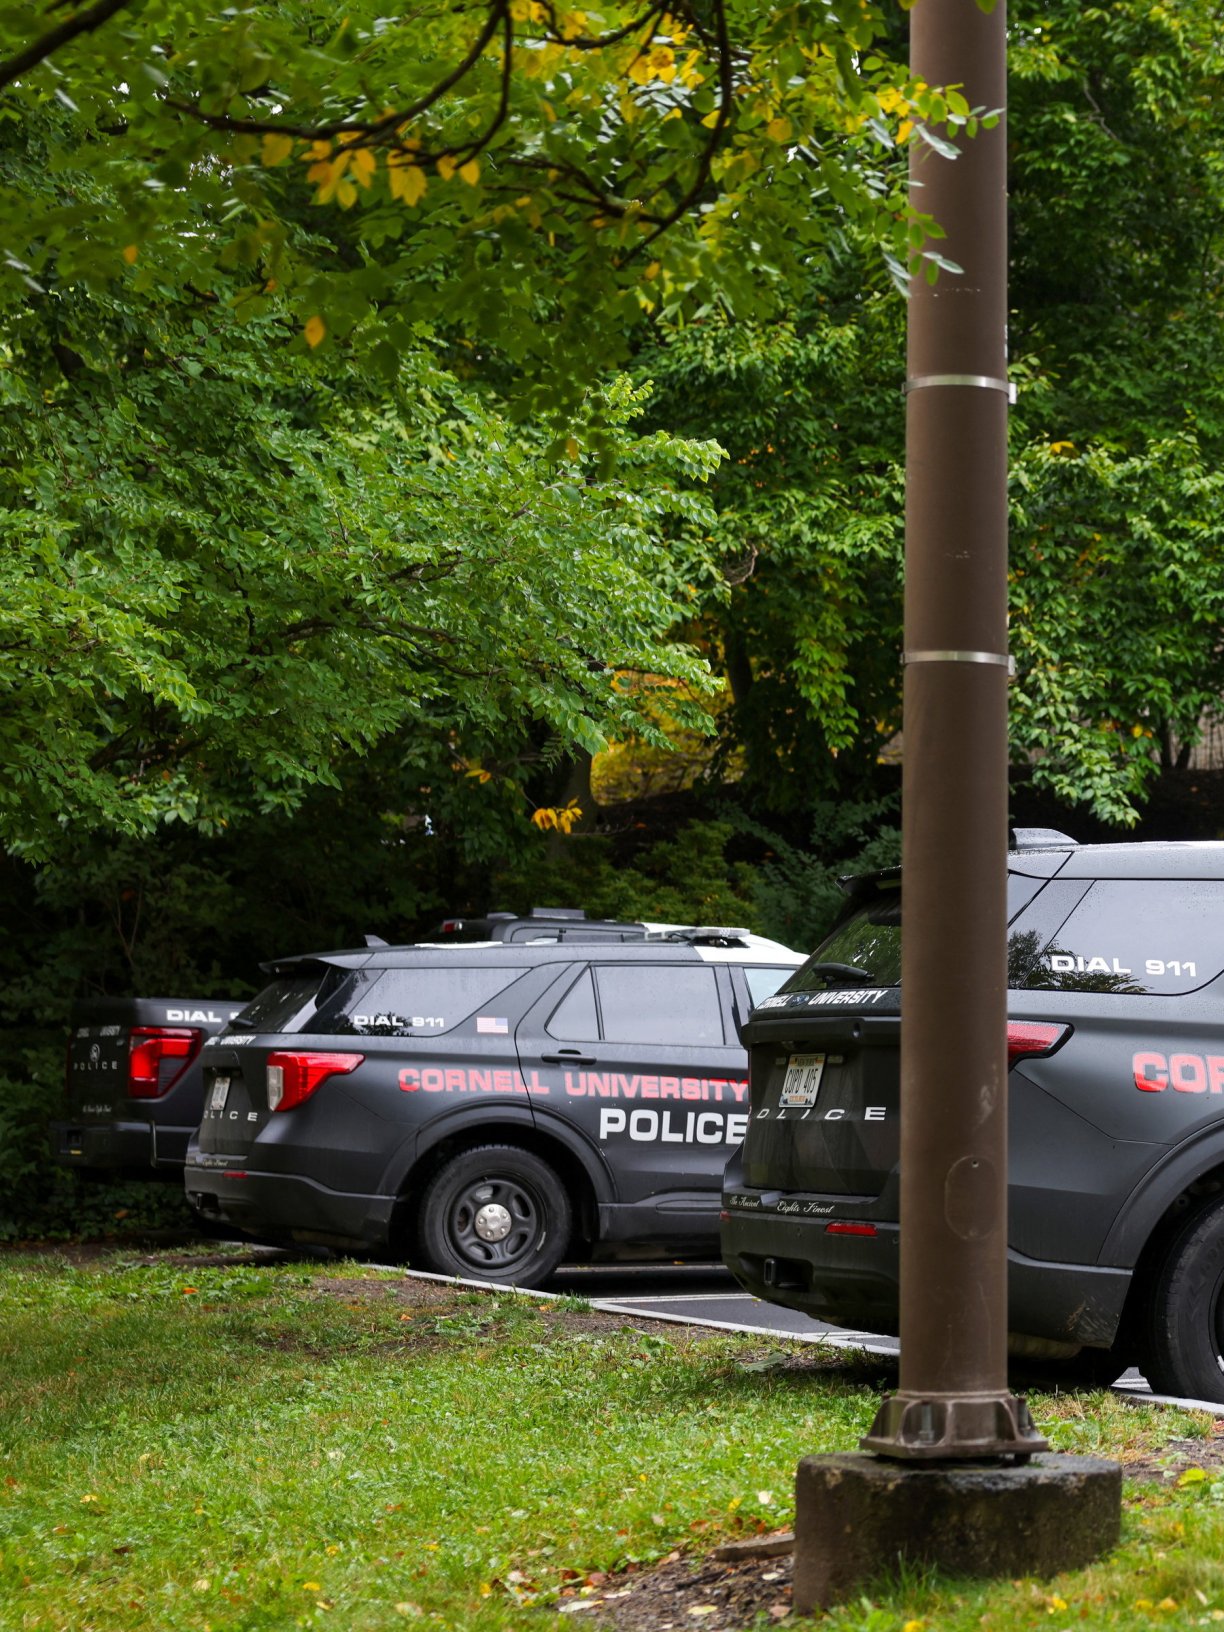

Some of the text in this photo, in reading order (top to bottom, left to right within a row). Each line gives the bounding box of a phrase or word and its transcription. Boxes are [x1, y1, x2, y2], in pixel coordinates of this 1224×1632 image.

[1051, 956, 1197, 977] DIAL 911
[807, 990, 889, 1006] UNIVERSITY
[165, 1009, 222, 1023] DIAL
[353, 1014, 445, 1028] DIAL 911
[398, 1068, 748, 1102] CORNELL UNIVERSITY
[203, 1110, 258, 1122] OLICE
[749, 1105, 887, 1121] OLICE
[600, 1108, 748, 1144] POLICE
[803, 1202, 835, 1214] Finest
